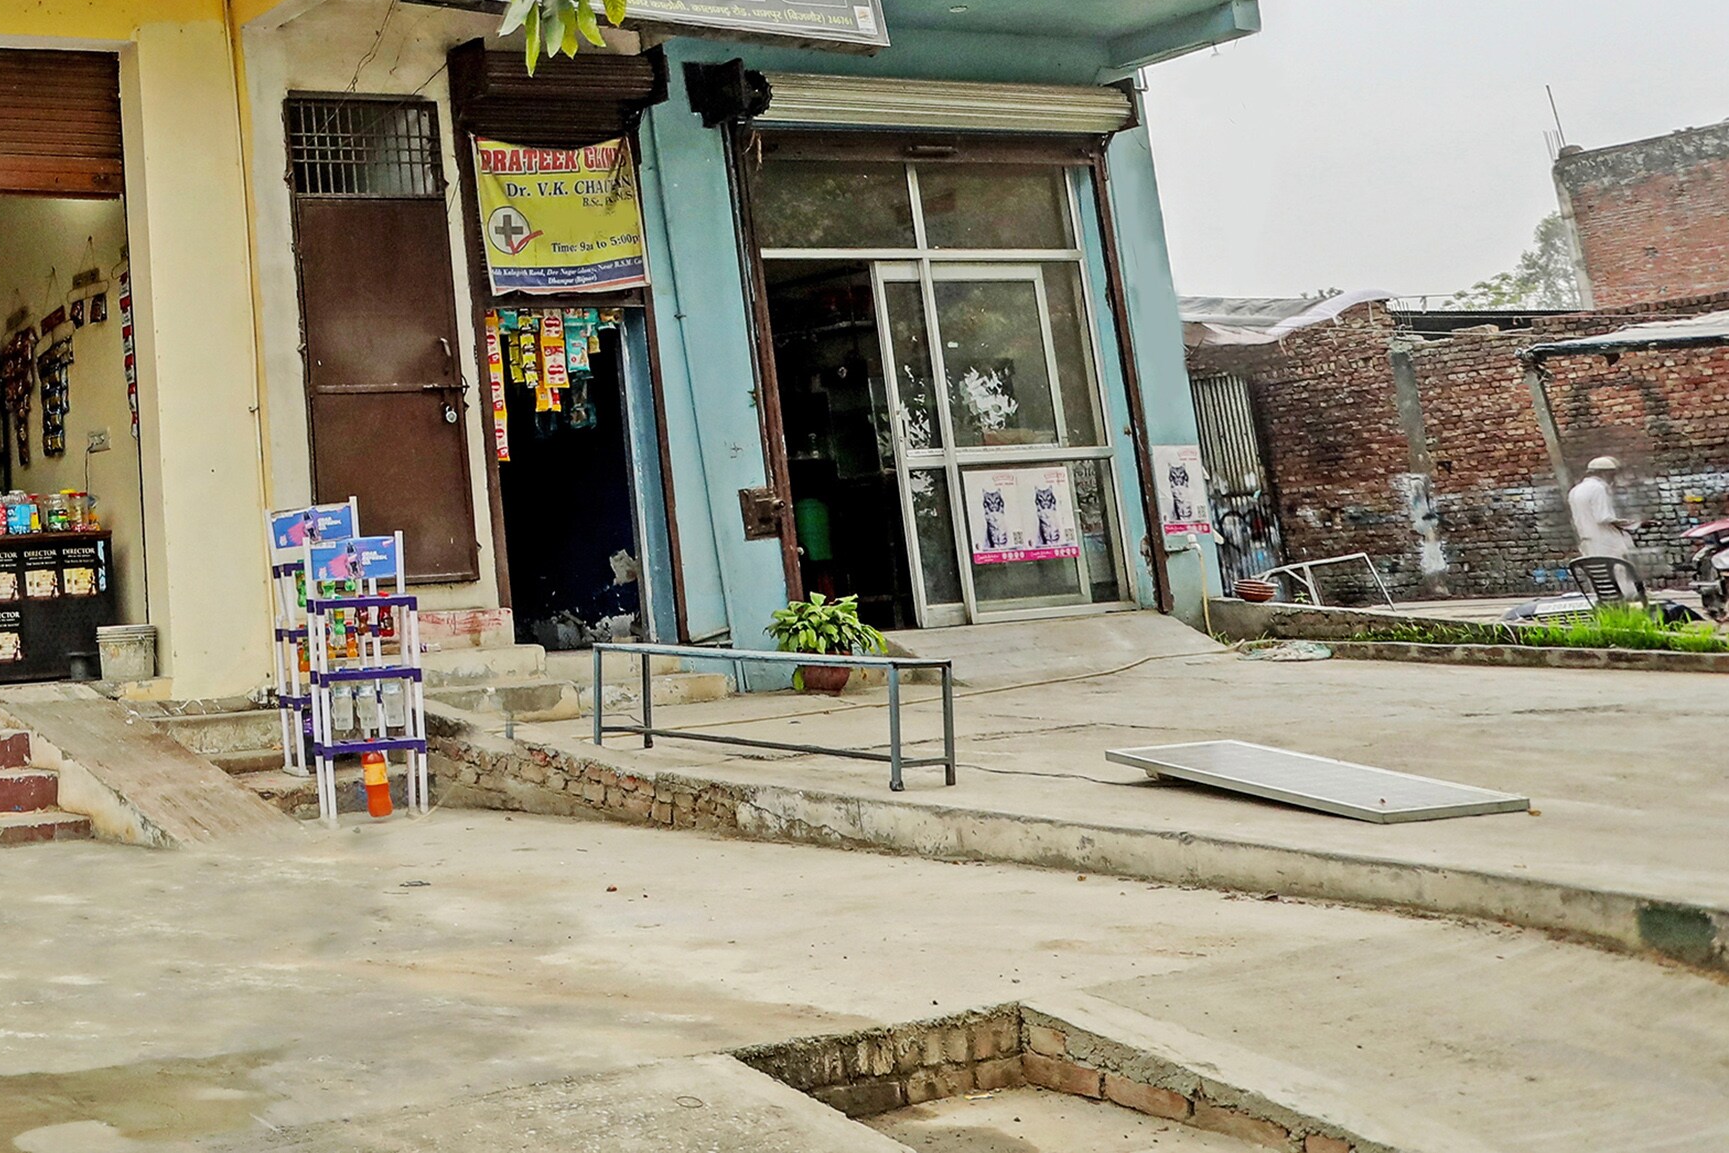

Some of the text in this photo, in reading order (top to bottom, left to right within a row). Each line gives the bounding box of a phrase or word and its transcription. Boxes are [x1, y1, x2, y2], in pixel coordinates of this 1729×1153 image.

[480, 149, 579, 174] PRATEEK
[506, 182, 568, 197] Dr. V.K.
[551, 240, 607, 253] Time: to
[24, 549, 57, 558] DIRECTOR
